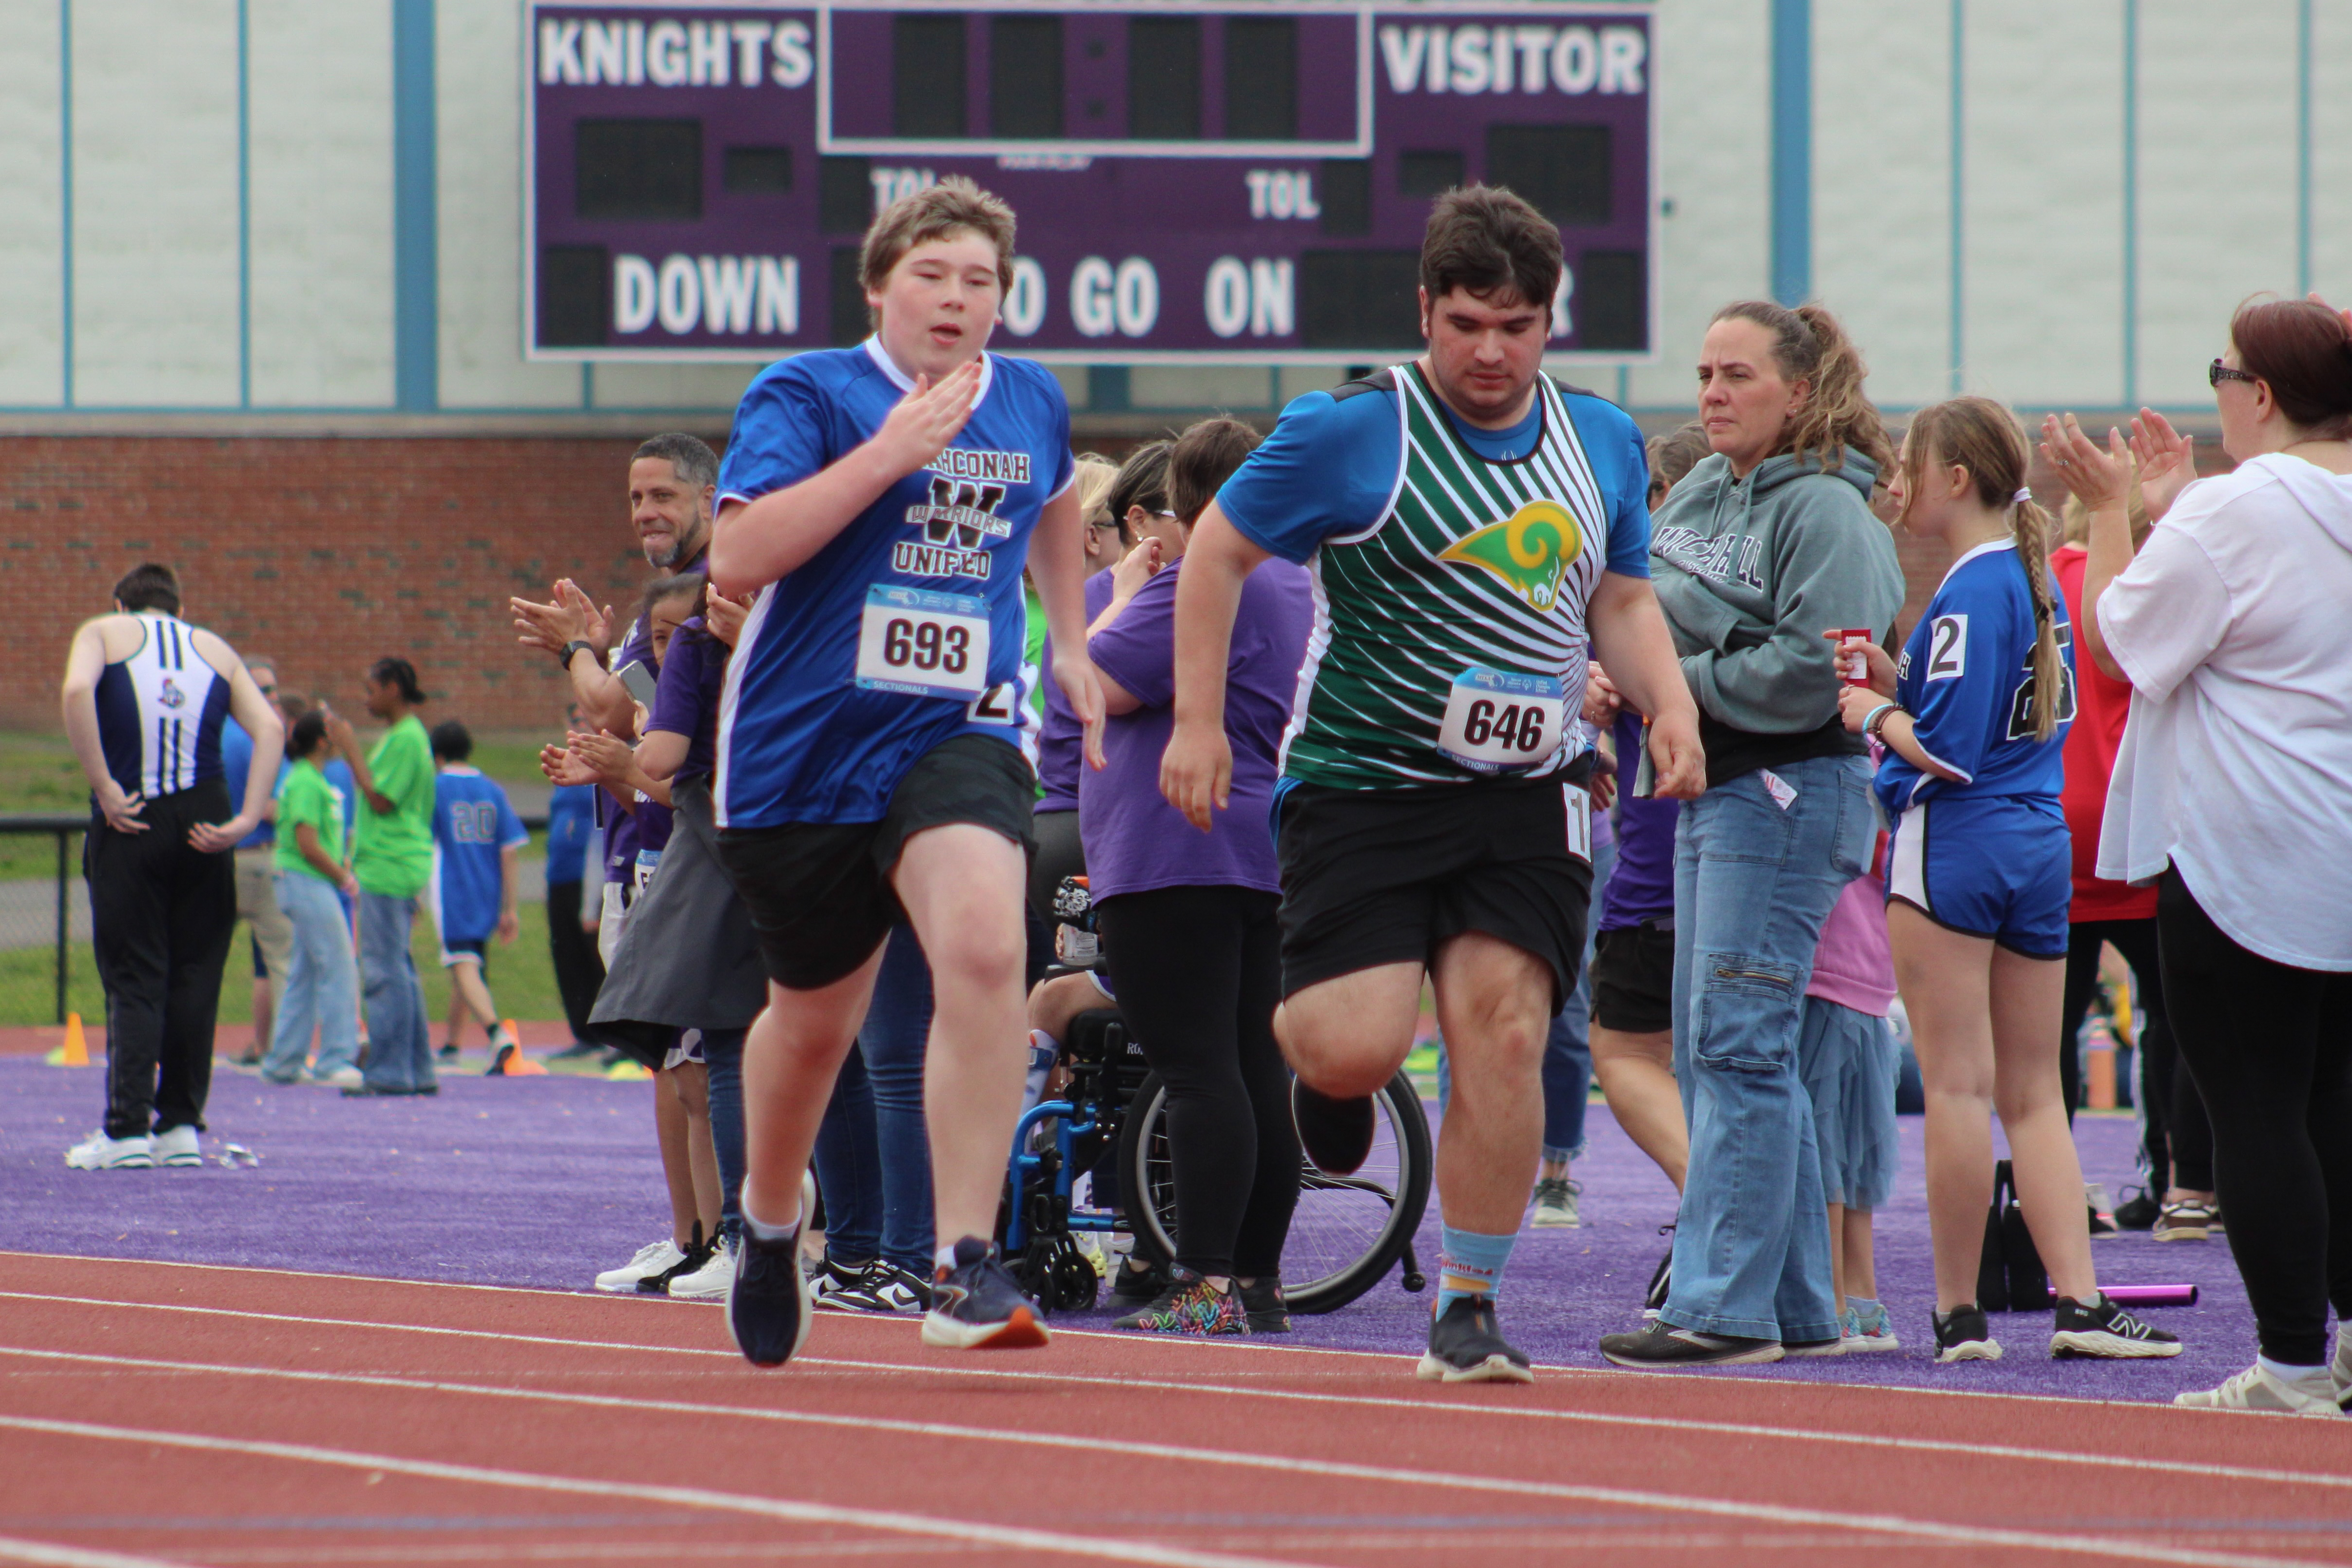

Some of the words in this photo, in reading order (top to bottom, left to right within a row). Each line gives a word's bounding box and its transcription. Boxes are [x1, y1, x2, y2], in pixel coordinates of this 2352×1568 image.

[539, 19, 813, 87] KNIGHTS
[1380, 25, 1646, 94] VISITOR
[1245, 170, 1321, 219] TOL
[613, 255, 798, 334] DOWN
[1069, 255, 1160, 338] GO
[1205, 256, 1295, 337] ON
[884, 618, 970, 674] 693
[1930, 618, 1959, 675] 2
[874, 681, 928, 694] SECTIONALS
[1464, 699, 1545, 752] 646
[451, 801, 497, 844] 20
[1571, 792, 1586, 852] 1
